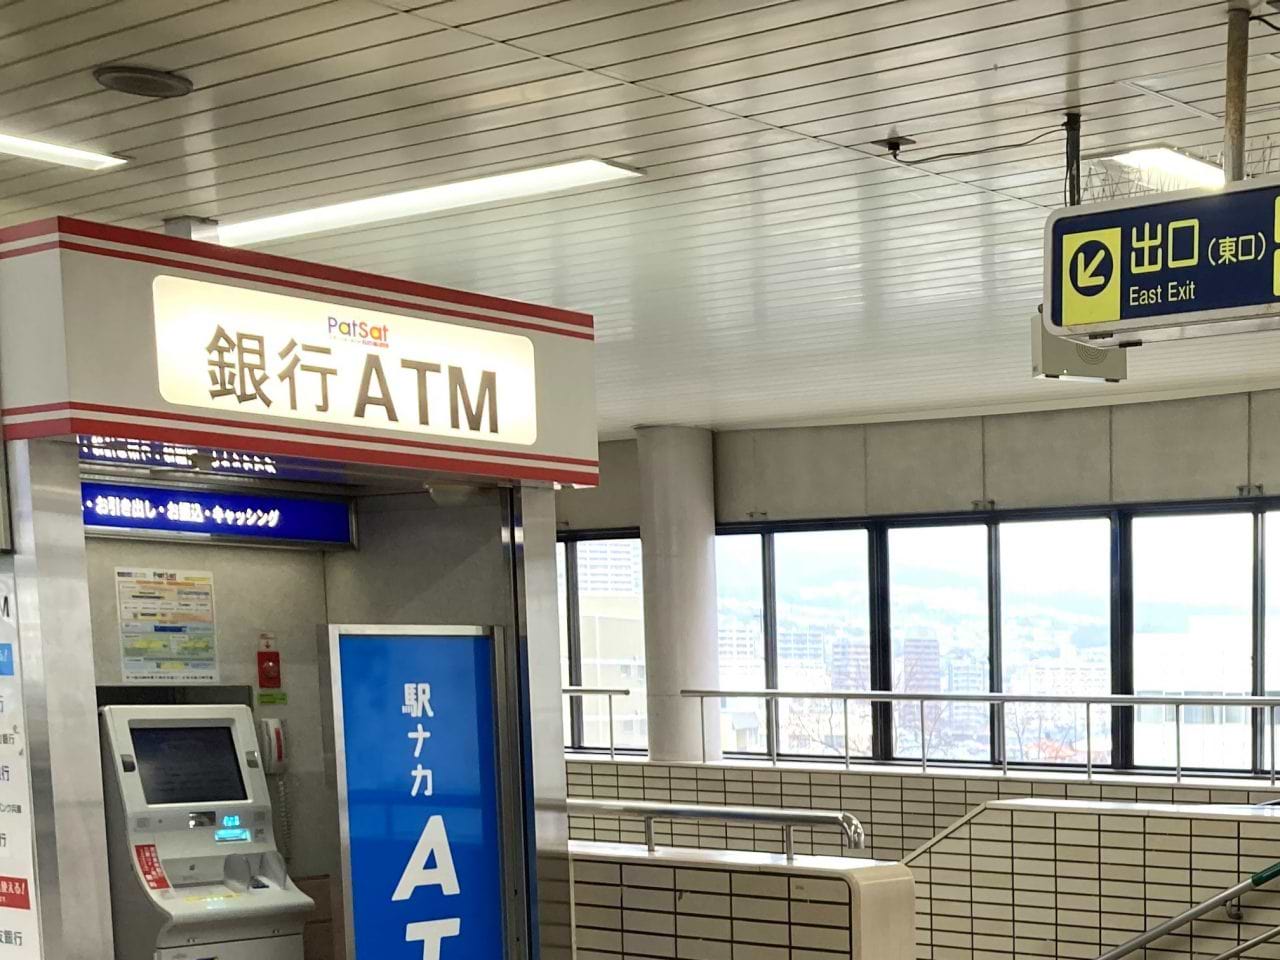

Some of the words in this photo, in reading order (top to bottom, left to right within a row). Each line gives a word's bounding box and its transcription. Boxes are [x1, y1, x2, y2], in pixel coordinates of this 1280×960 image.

[1130, 218, 1199, 275] 出口
[1207, 231, 1267, 266] (東口)
[1130, 286, 1162, 305] East
[1168, 280, 1195, 300] Exit
[328, 316, 389, 342] PatSat
[402, 682, 434, 796] 駅ナカ
